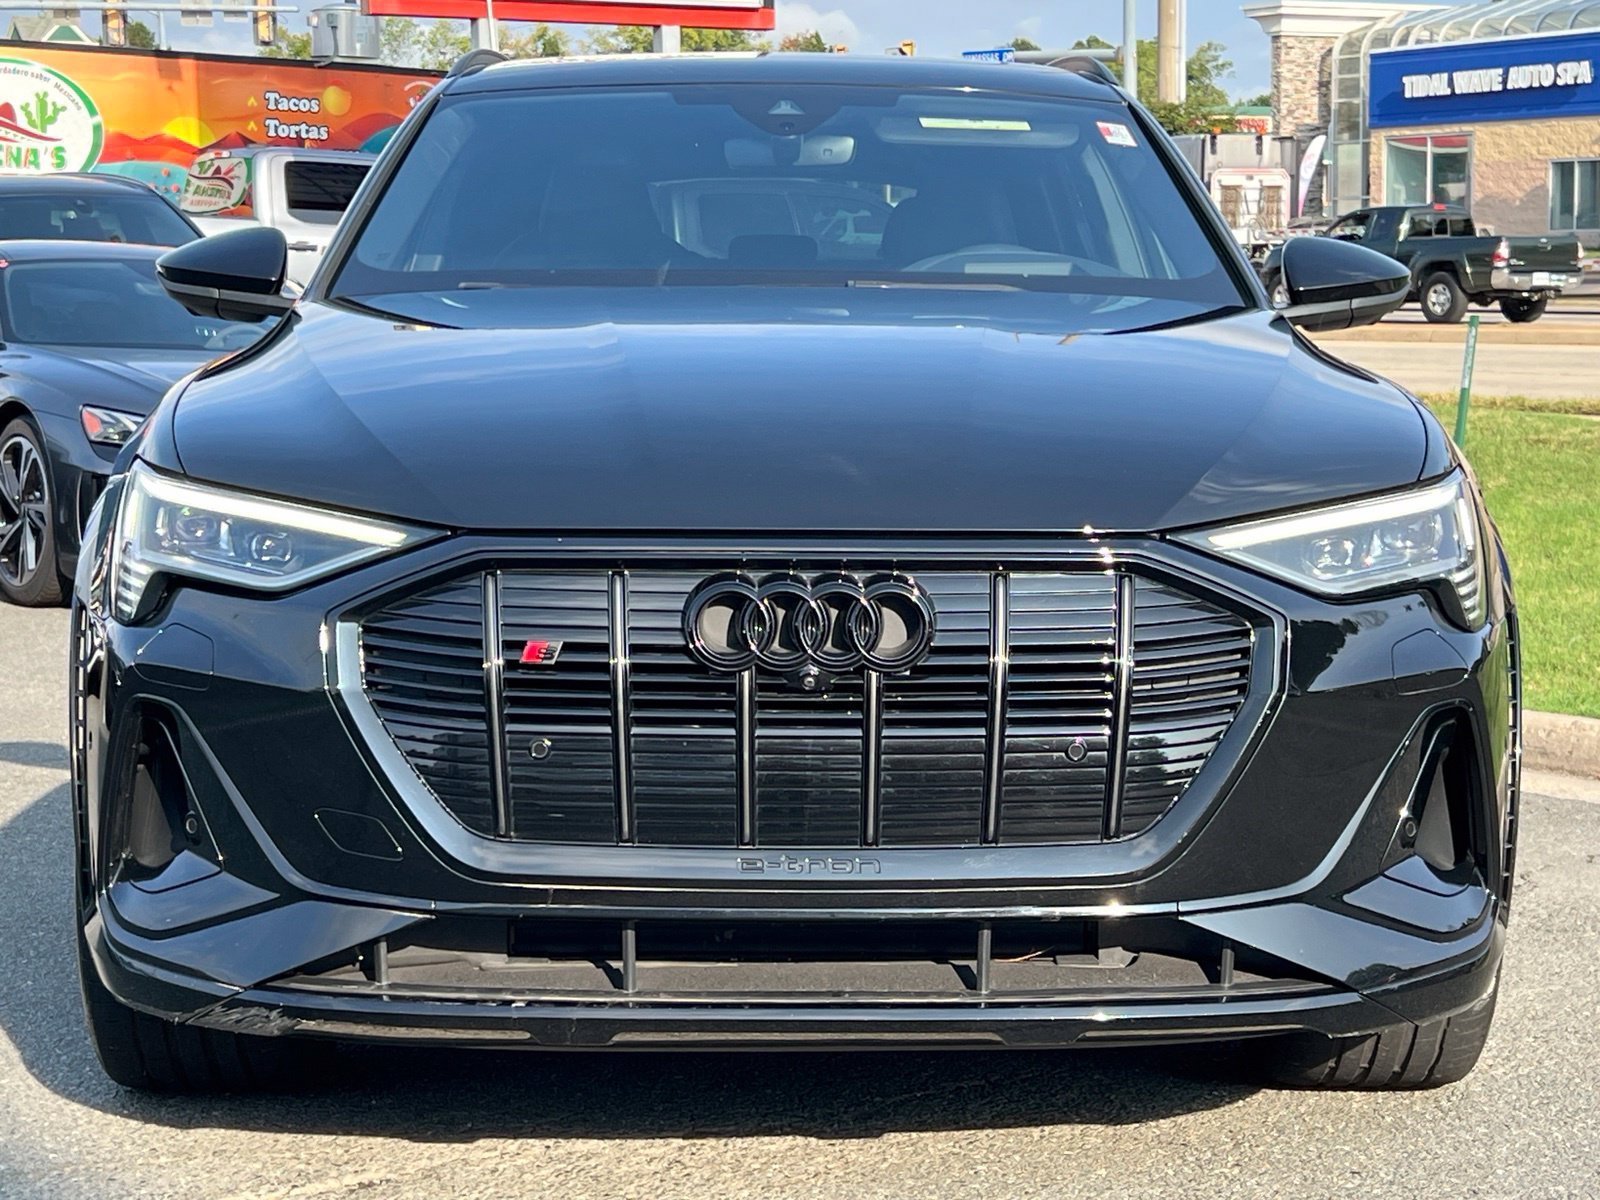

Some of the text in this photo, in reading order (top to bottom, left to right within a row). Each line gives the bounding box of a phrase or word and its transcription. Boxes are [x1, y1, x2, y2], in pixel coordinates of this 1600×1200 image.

[1402, 60, 1592, 98] TIDAL WAVE AUTO SPA
[264, 91, 320, 113] Tacos
[264, 118, 329, 140] Tortas
[737, 855, 881, 874] e-tron
